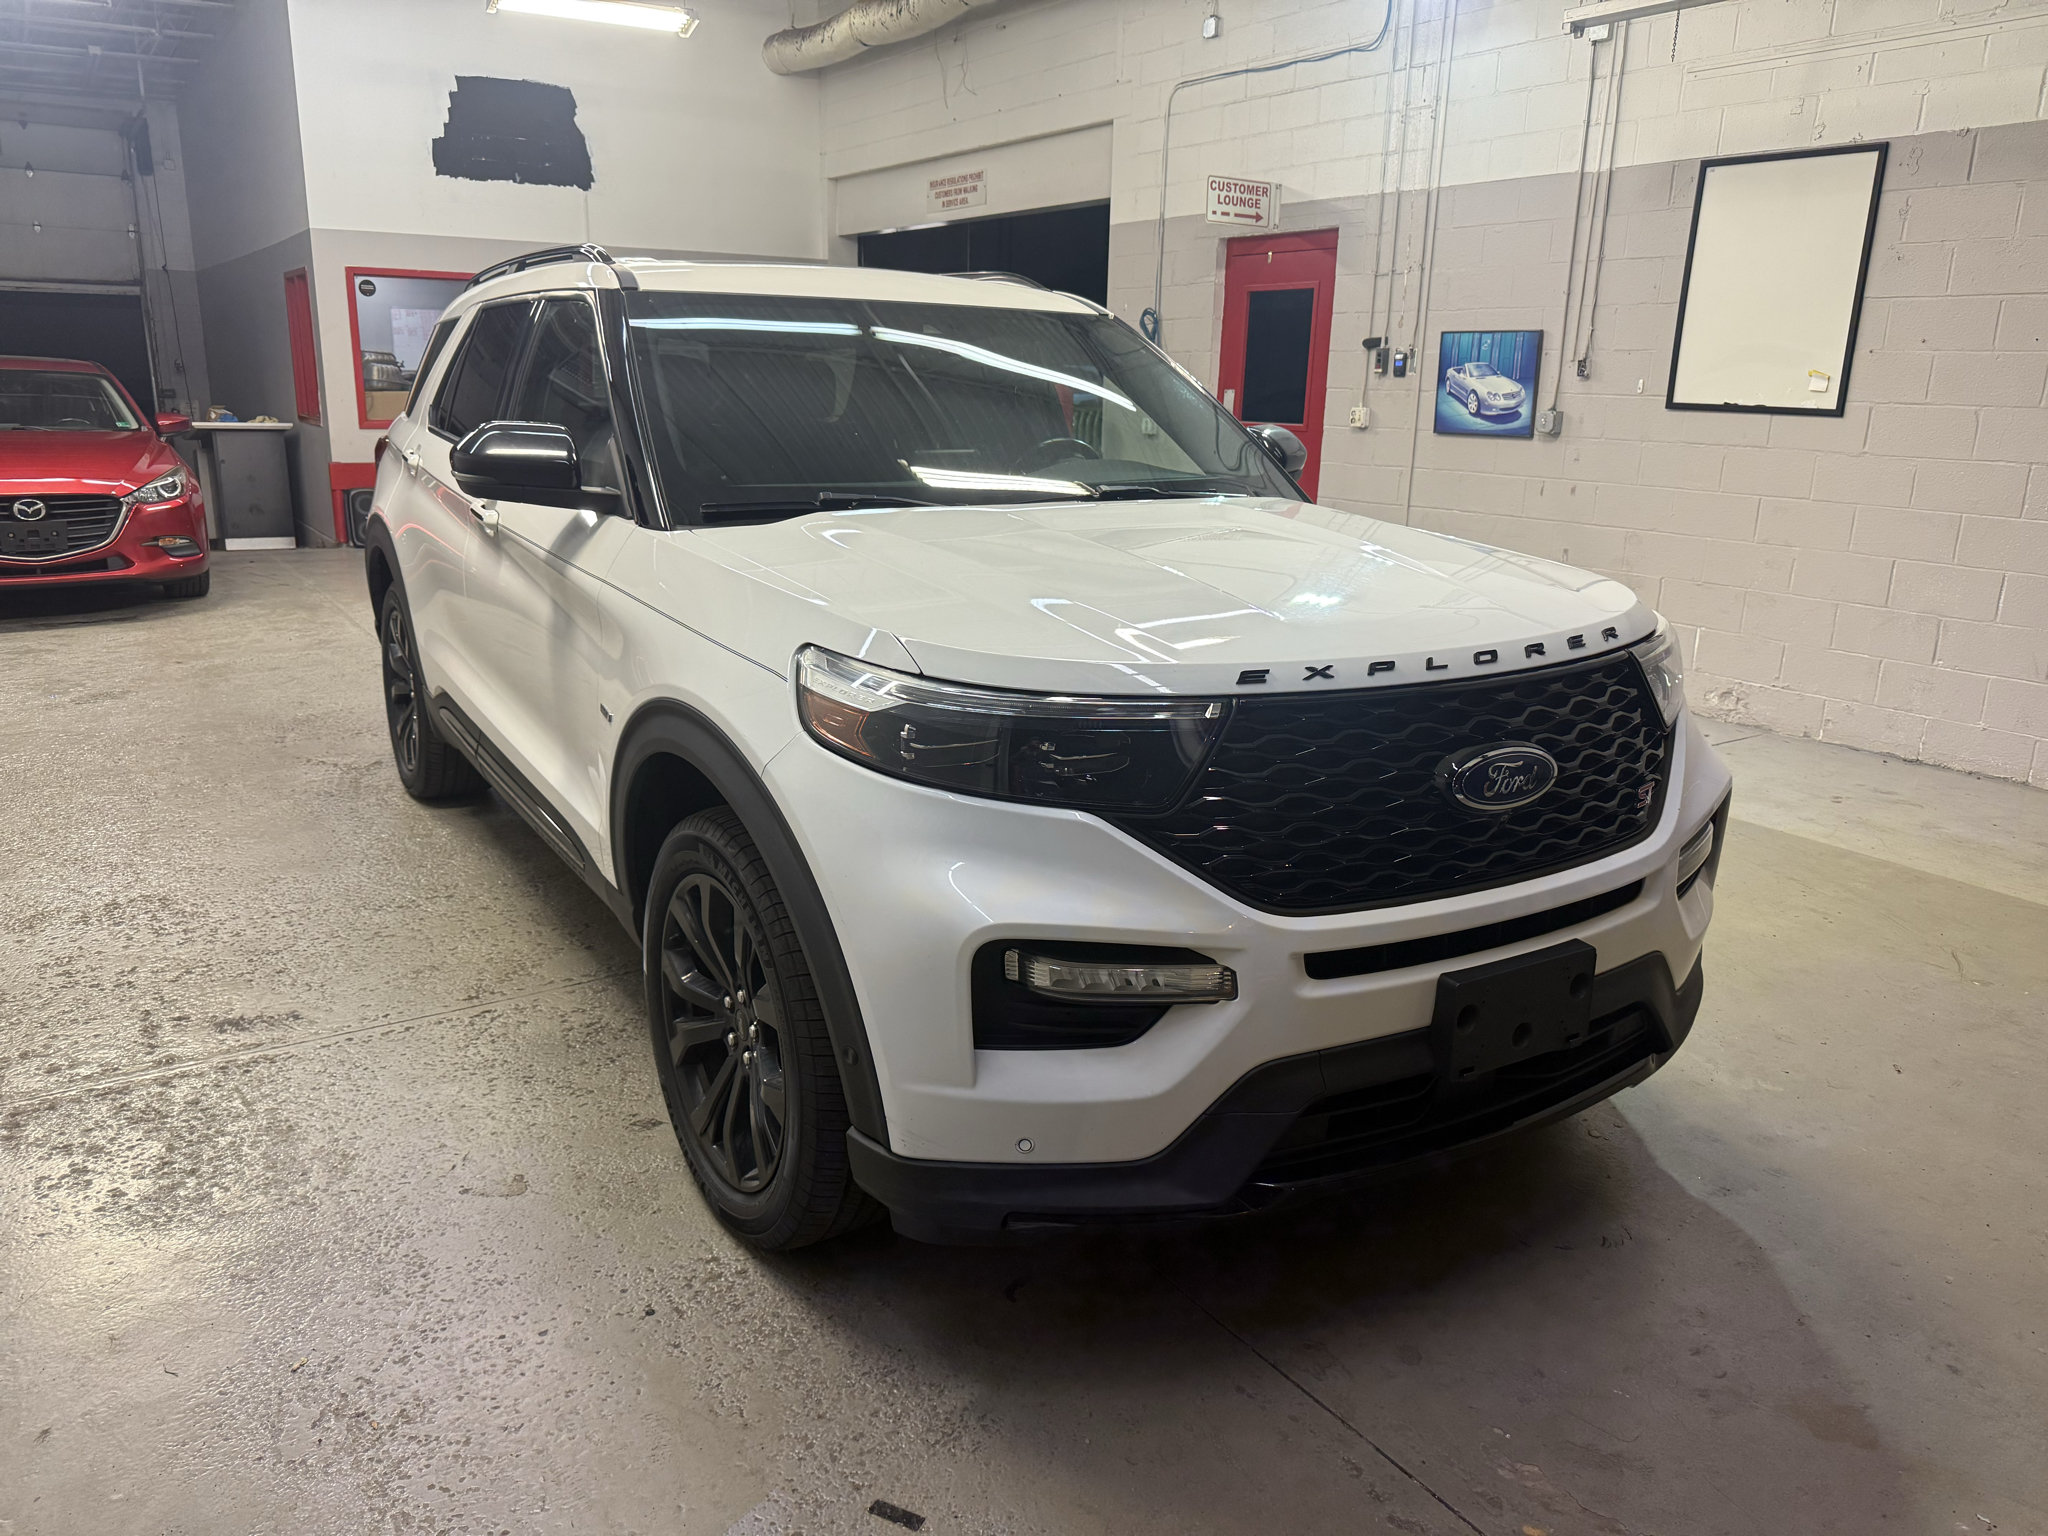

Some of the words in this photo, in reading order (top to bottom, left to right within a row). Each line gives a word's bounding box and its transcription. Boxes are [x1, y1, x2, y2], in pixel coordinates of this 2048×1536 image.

[1210, 180, 1269, 198] CUSTOMER
[1217, 194, 1262, 209] LOUNGE
[1236, 626, 1620, 685] EXPLORER
[1483, 760, 1538, 798] Ford
